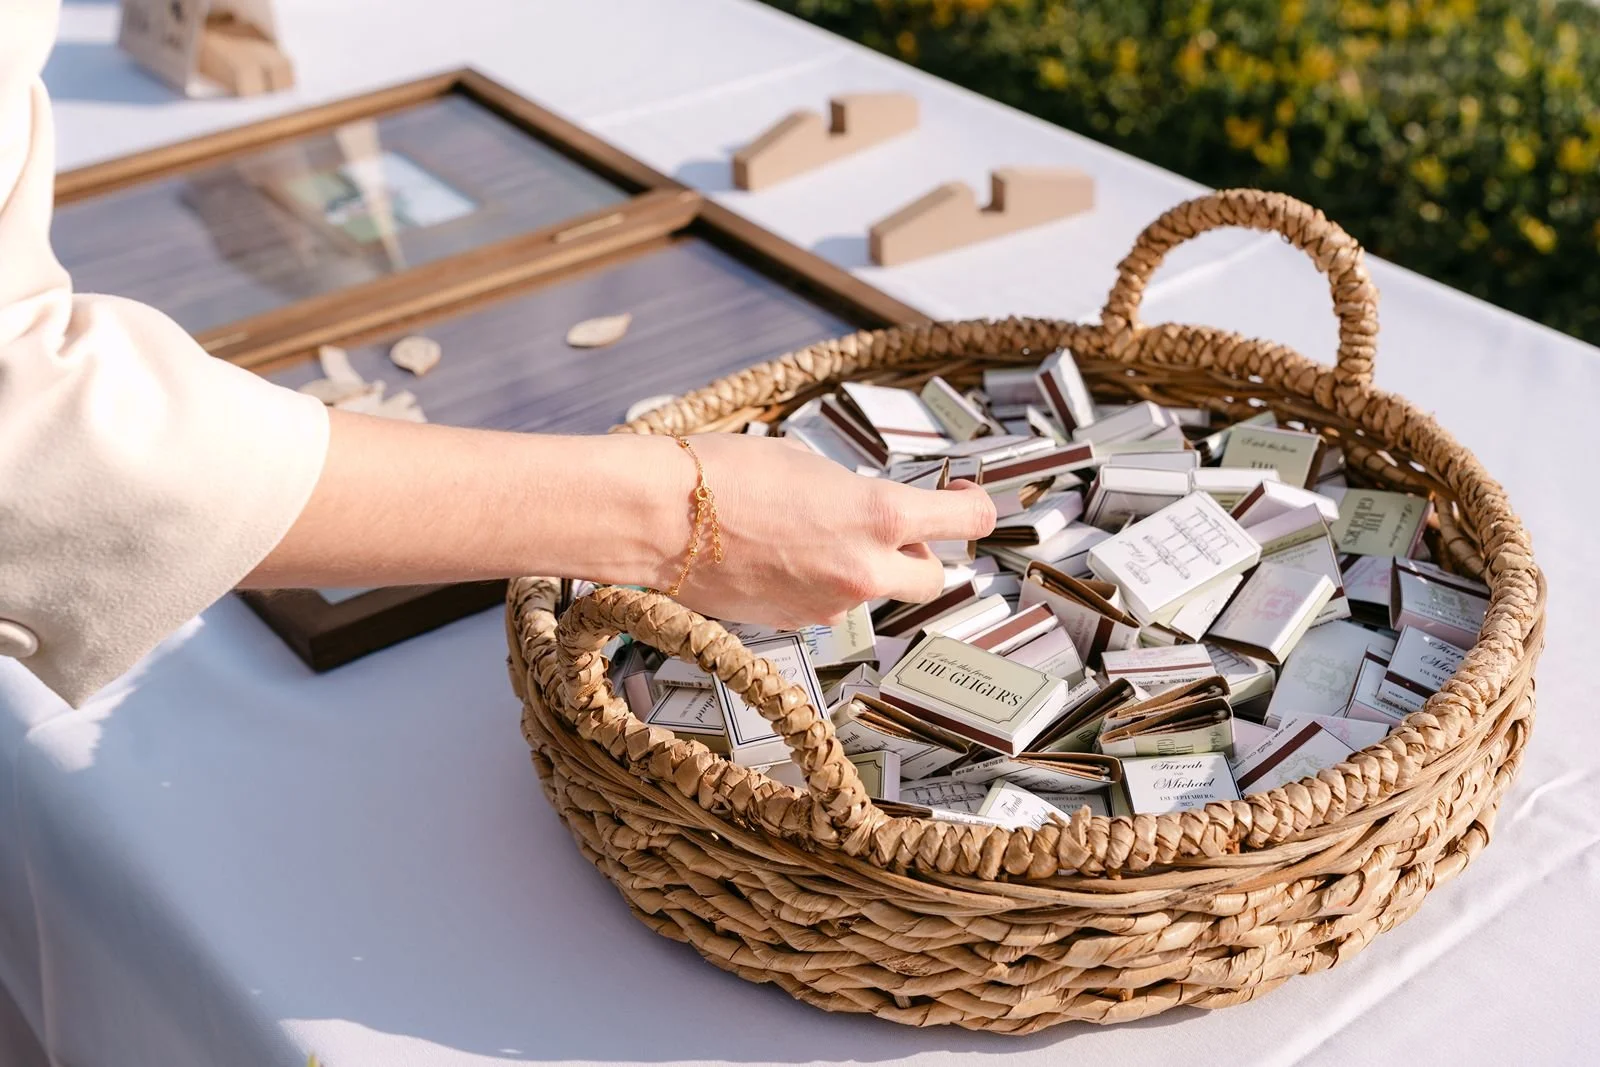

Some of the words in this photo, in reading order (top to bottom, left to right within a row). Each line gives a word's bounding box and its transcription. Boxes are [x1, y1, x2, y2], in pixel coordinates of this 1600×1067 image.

[1429, 640, 1465, 661] Farr
[957, 663, 972, 673] this
[969, 669, 993, 681] from
[916, 658, 951, 679] THE
[949, 670, 1023, 707] GEIGER'S
[1151, 760, 1204, 771] Farrah
[1153, 778, 1215, 790] Michael
